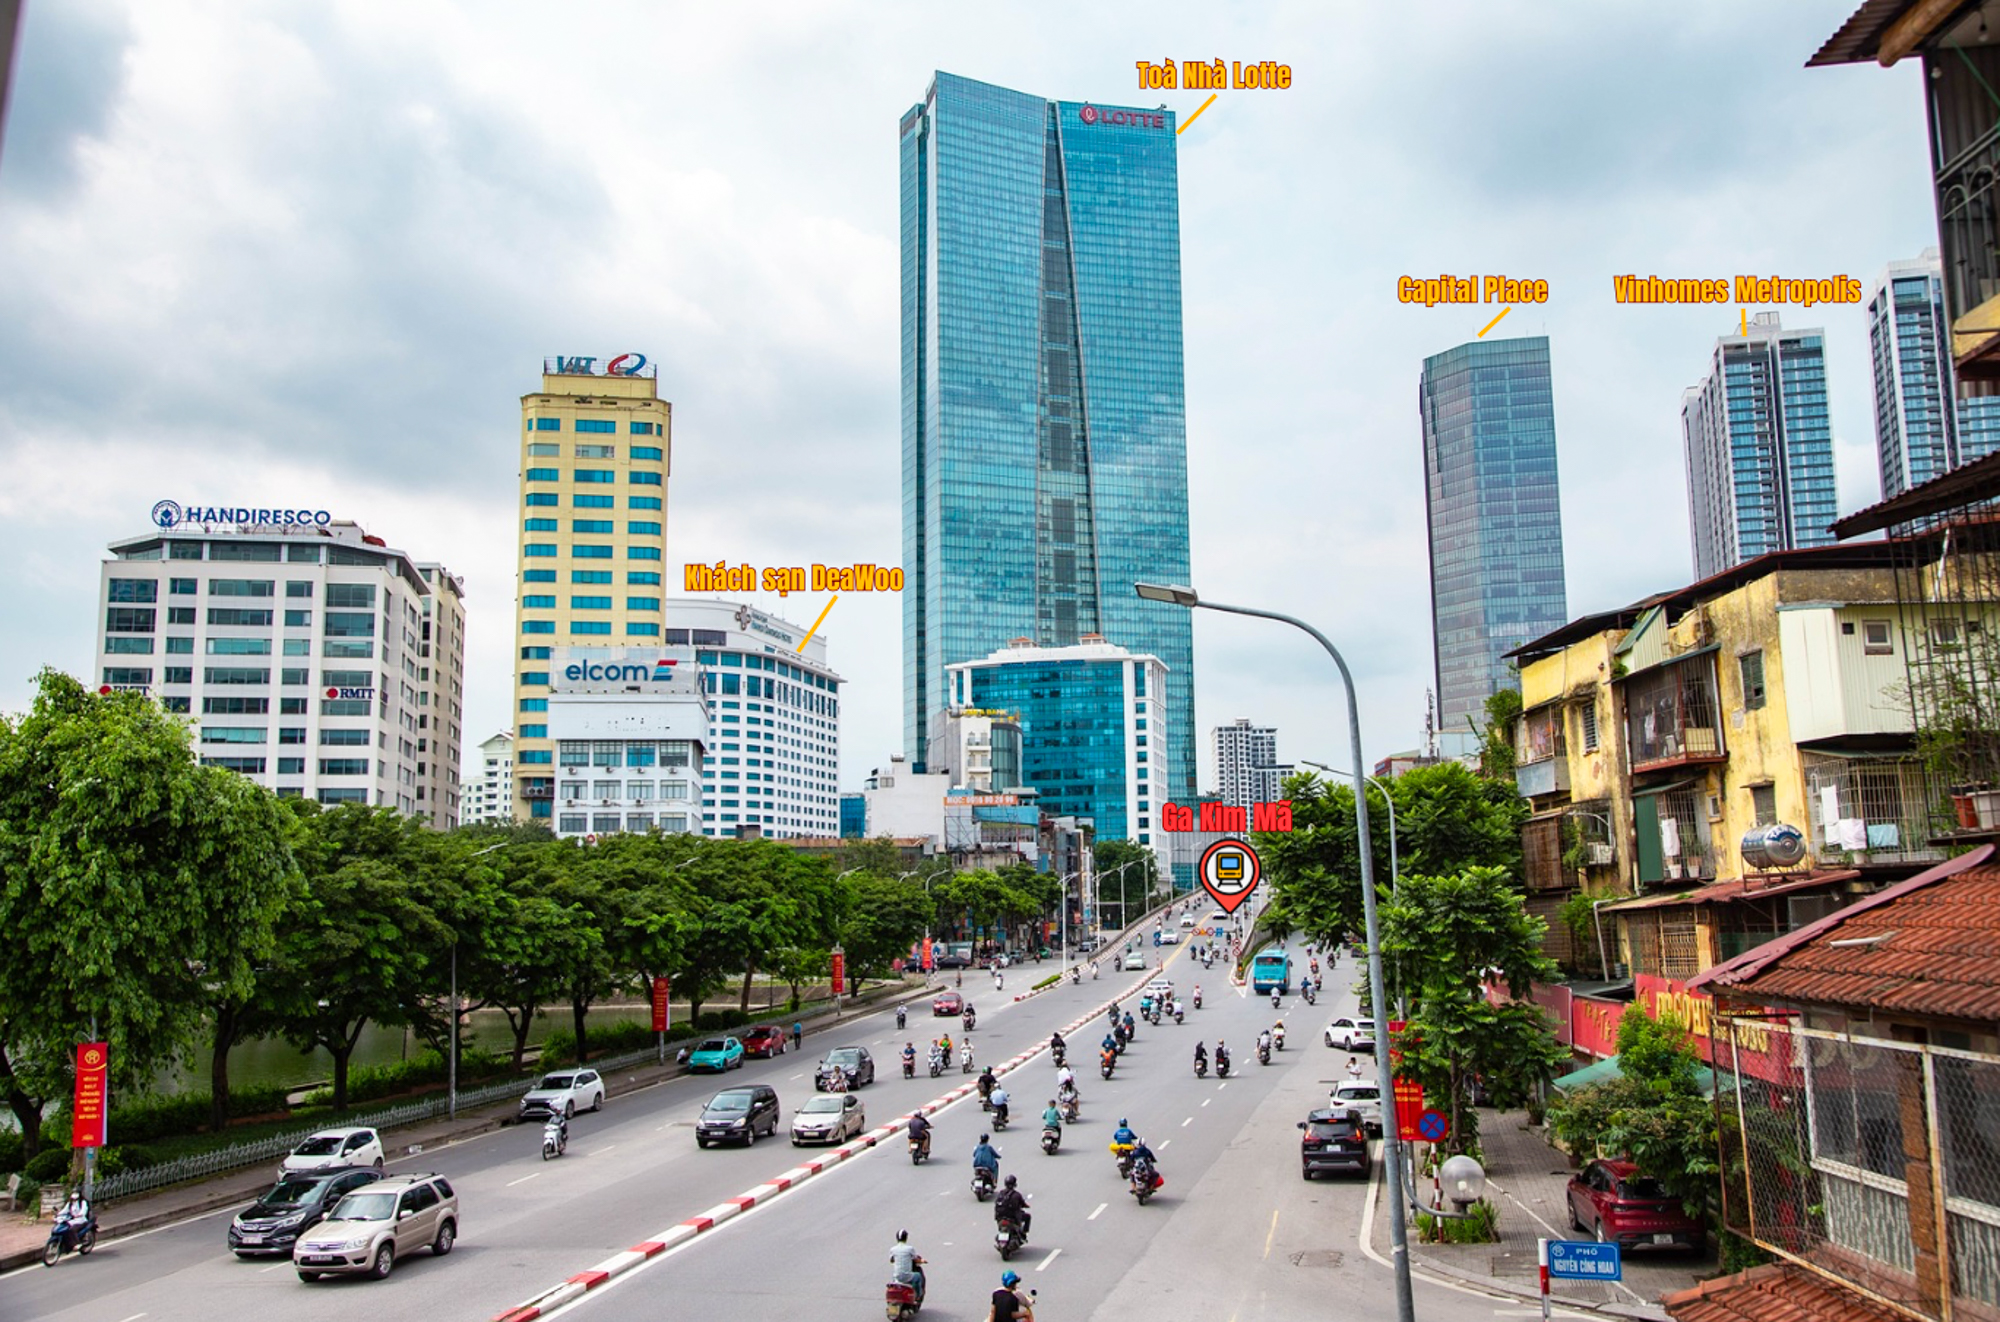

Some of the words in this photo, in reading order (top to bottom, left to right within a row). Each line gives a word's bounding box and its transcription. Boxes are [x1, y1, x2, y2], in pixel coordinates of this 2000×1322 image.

[1102, 110, 1164, 128] LOTTE
[557, 356, 597, 374] VIT
[186, 507, 331, 525] HANDIRESCO
[565, 659, 649, 682] elcom
[340, 688, 375, 700] RMIT
